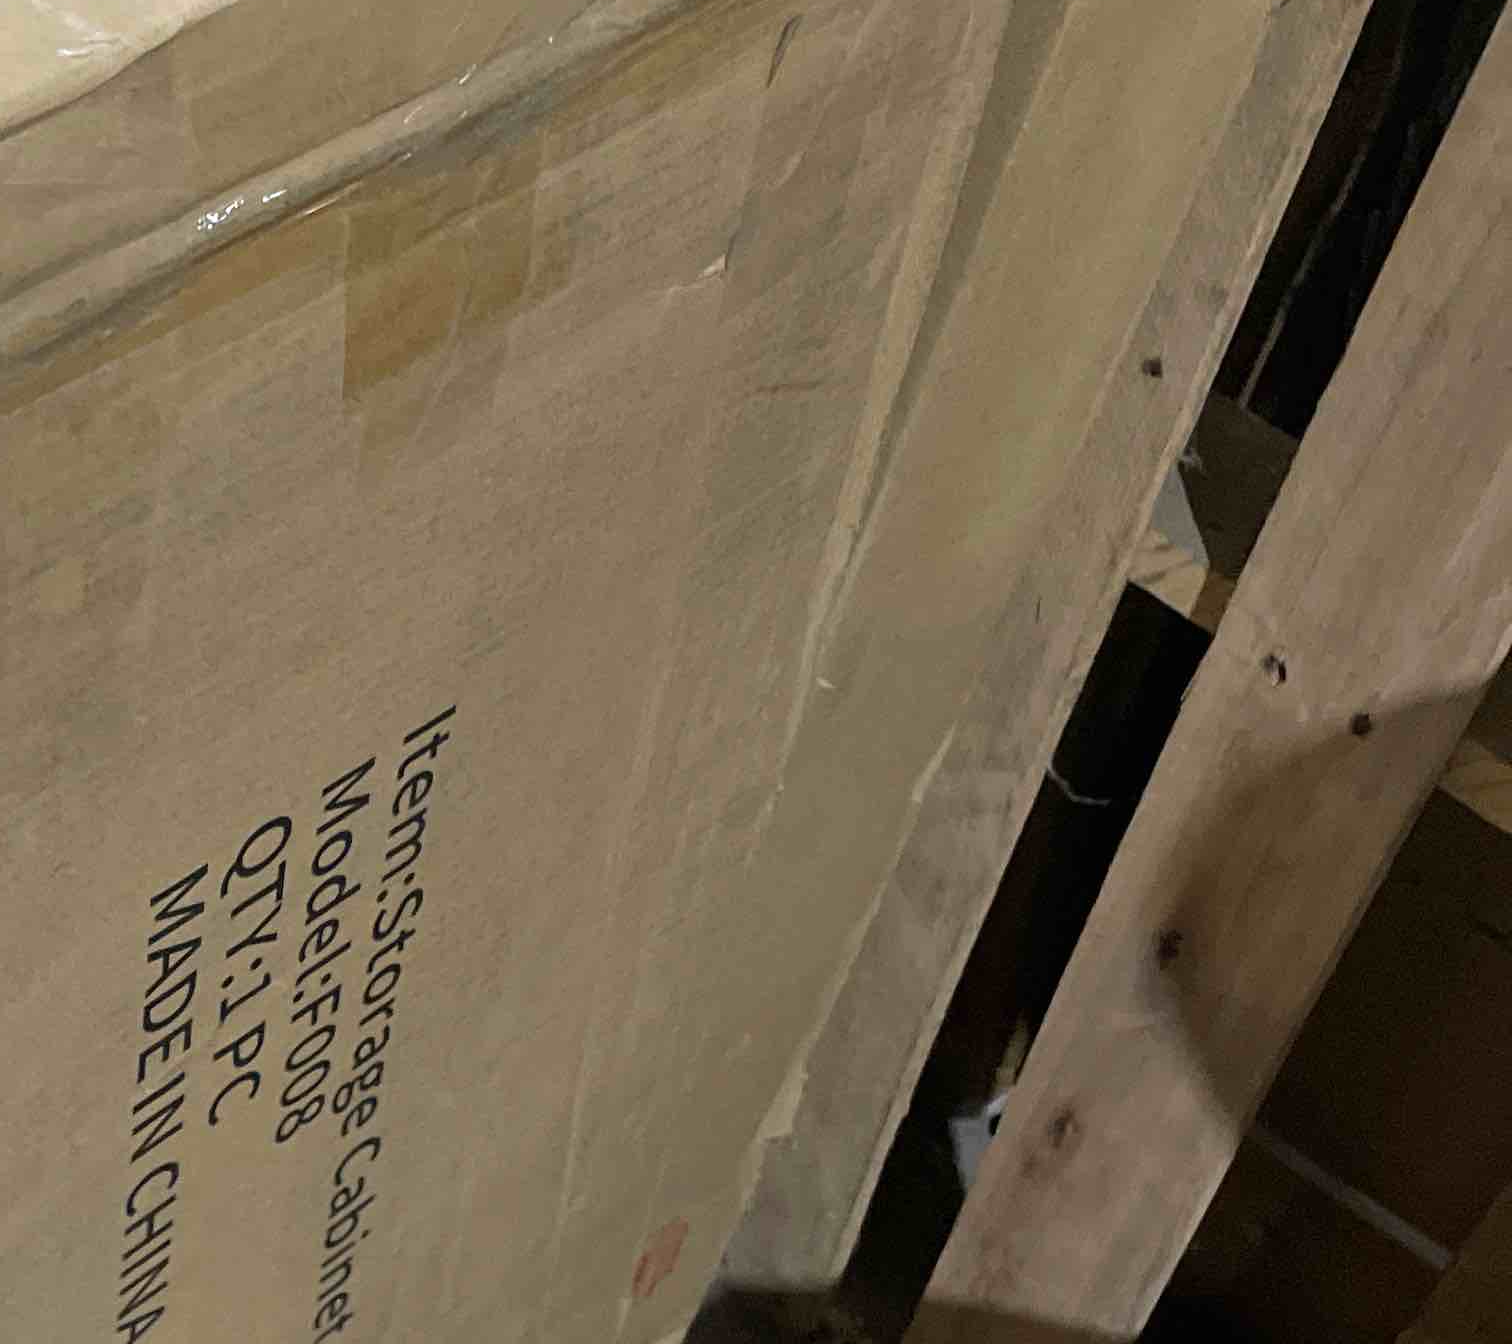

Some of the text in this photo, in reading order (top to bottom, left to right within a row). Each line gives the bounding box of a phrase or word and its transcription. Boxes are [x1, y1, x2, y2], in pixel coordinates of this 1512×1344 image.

[136, 863, 209, 1084] MADE
[275, 757, 376, 1144] Model:F008
[333, 705, 457, 1135] Item:Storage
[131, 1081, 185, 1163] IN
